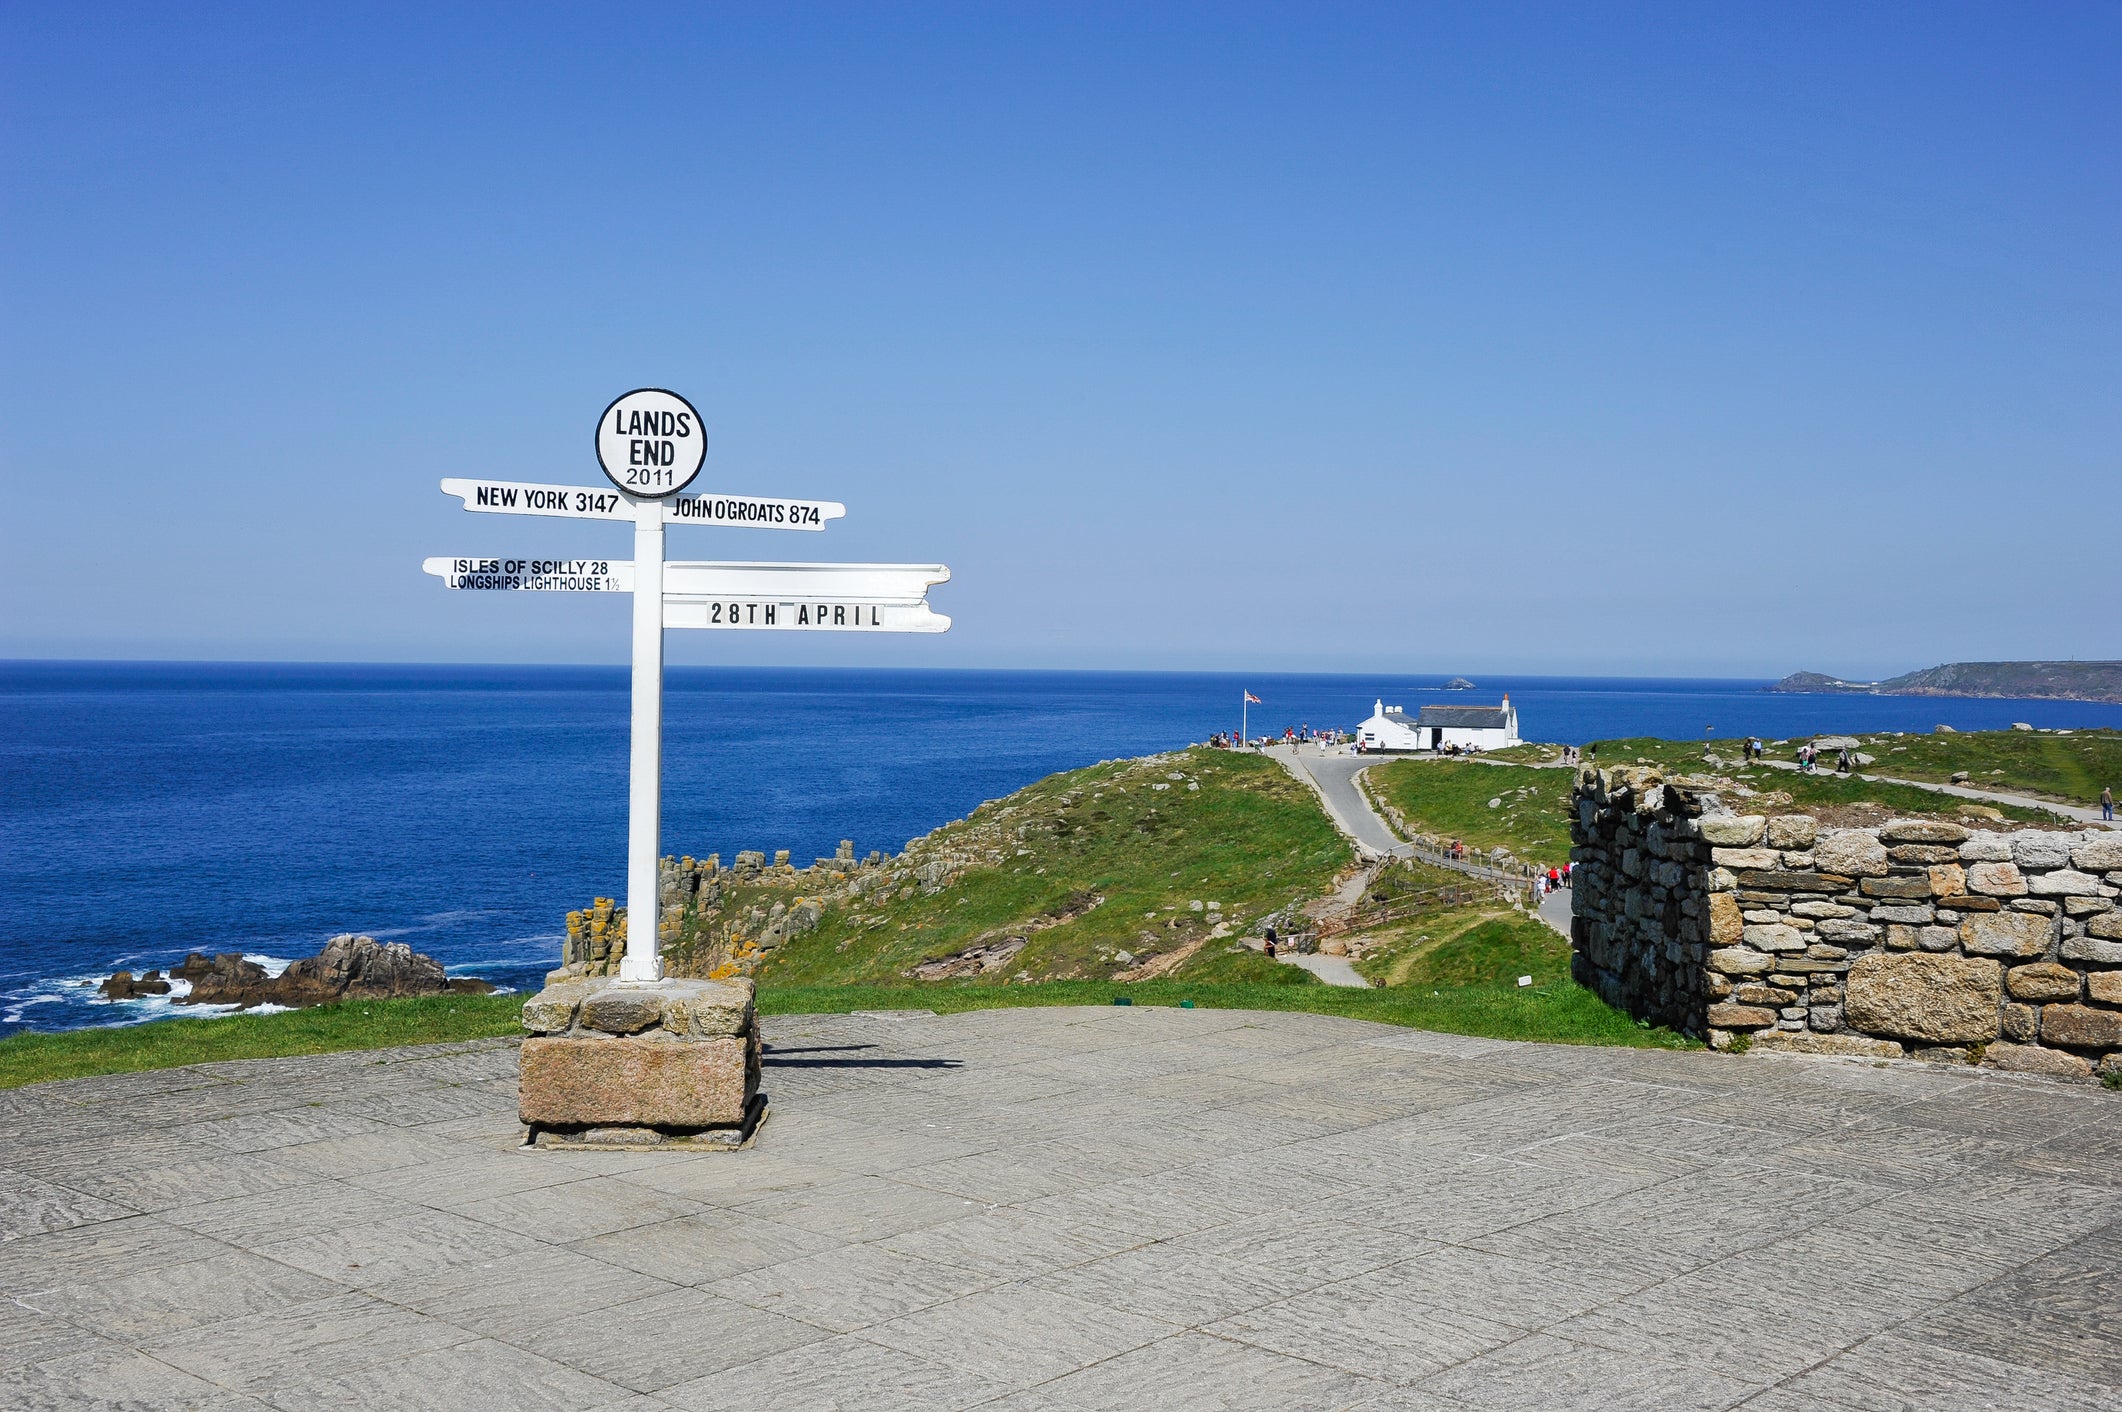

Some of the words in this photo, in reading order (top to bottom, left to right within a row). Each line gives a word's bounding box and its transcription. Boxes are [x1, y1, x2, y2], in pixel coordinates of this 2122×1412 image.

[616, 409, 691, 438] LANDS
[629, 439, 675, 467] END
[625, 467, 674, 486] 2011
[477, 486, 519, 508] NEW
[524, 489, 569, 511] YORK
[575, 492, 619, 513] 3147
[673, 498, 713, 519] JOHN
[714, 500, 785, 523] O'GROATS
[789, 505, 821, 525] 874
[453, 559, 500, 574] ISLES
[504, 560, 527, 575] OF
[531, 560, 587, 575] SCILLY
[591, 561, 608, 575] 28
[450, 575, 520, 590] LONGSHIPS
[524, 576, 601, 591] LIGHTHOUSE
[711, 602, 776, 625] 28TH
[798, 604, 880, 626] APRIL
